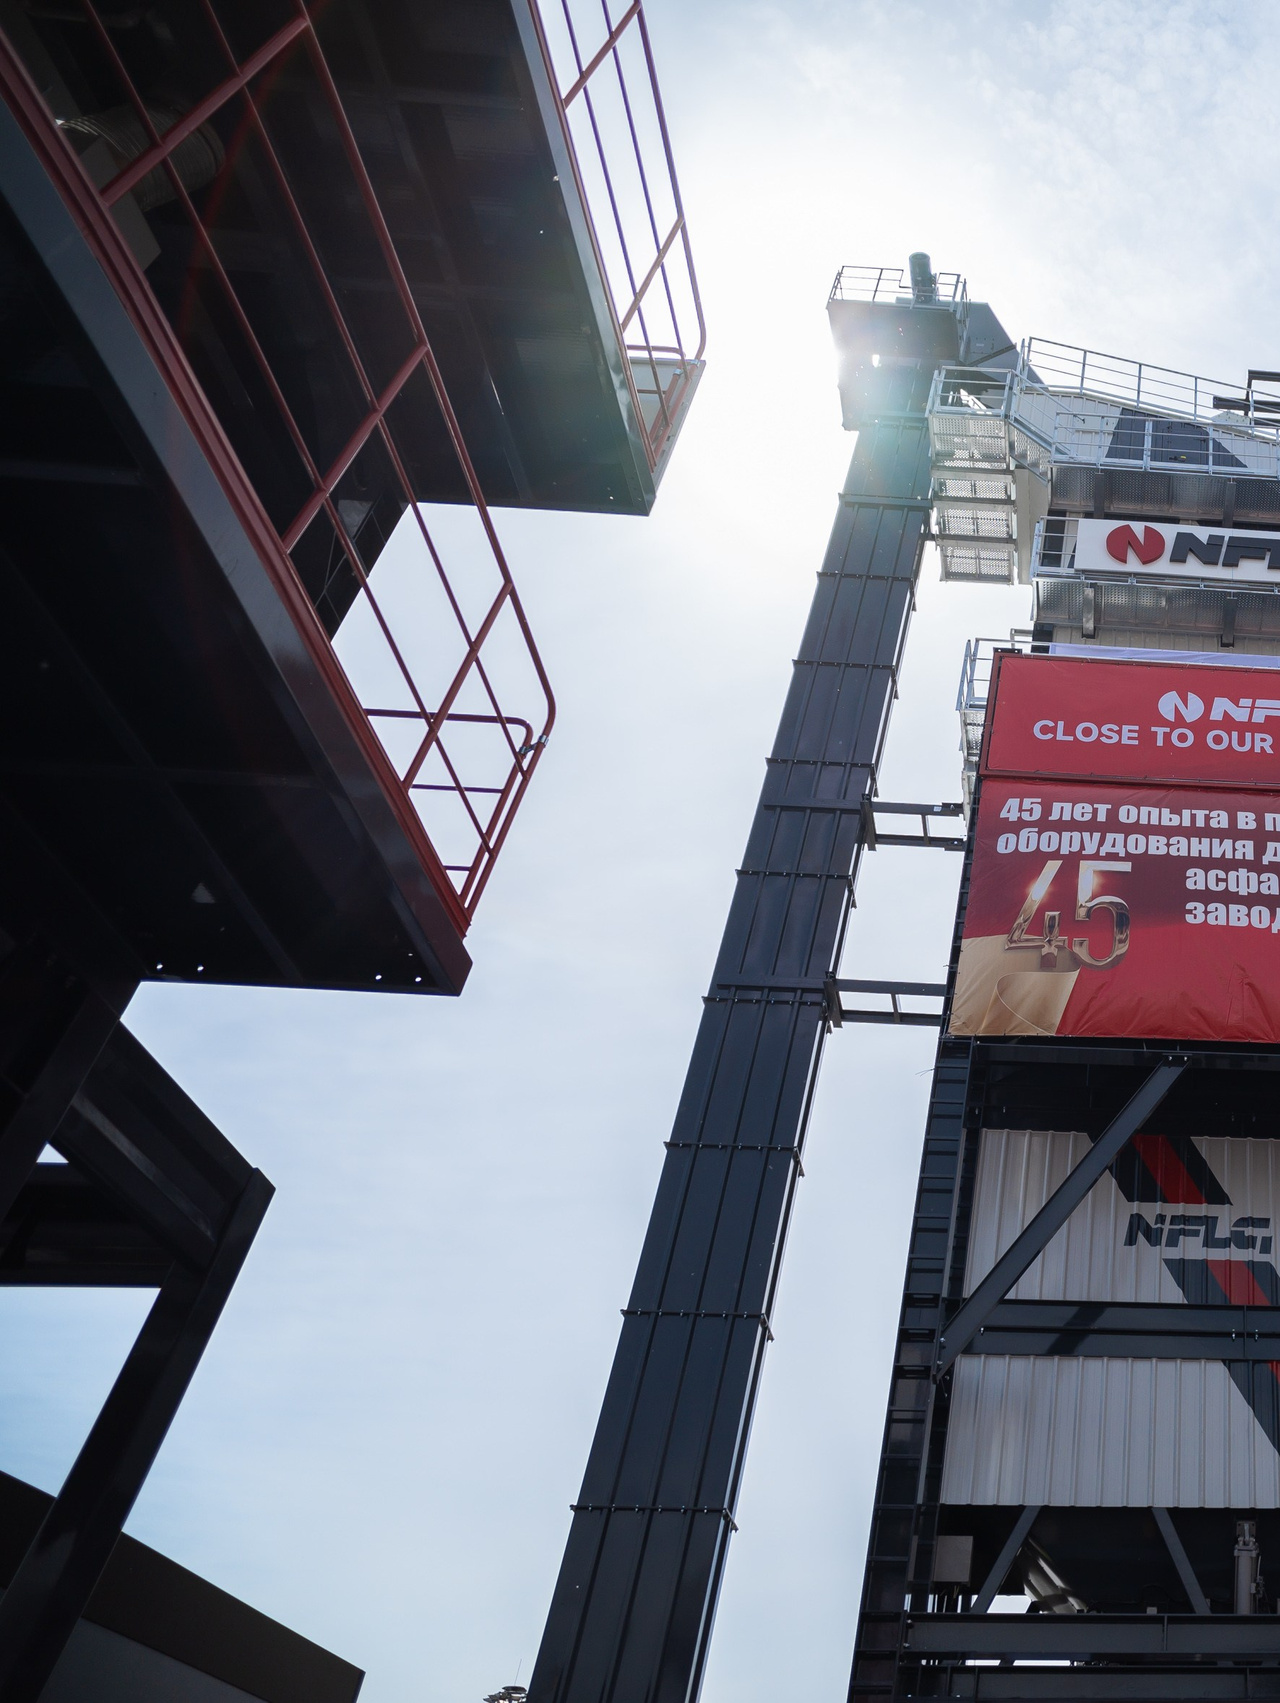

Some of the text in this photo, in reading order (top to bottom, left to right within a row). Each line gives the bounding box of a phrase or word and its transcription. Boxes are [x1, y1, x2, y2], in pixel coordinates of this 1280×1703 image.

[1033, 719, 1139, 745] CLOSE
[1151, 726, 1195, 749] TO
[1206, 729, 1274, 754] OUR
[1000, 797, 1042, 822] 45
[1049, 801, 1111, 824] лет
[1118, 804, 1229, 829] опыта
[1237, 811, 1257, 830] в
[996, 827, 1254, 860] оборудования
[1003, 860, 1132, 972] 45
